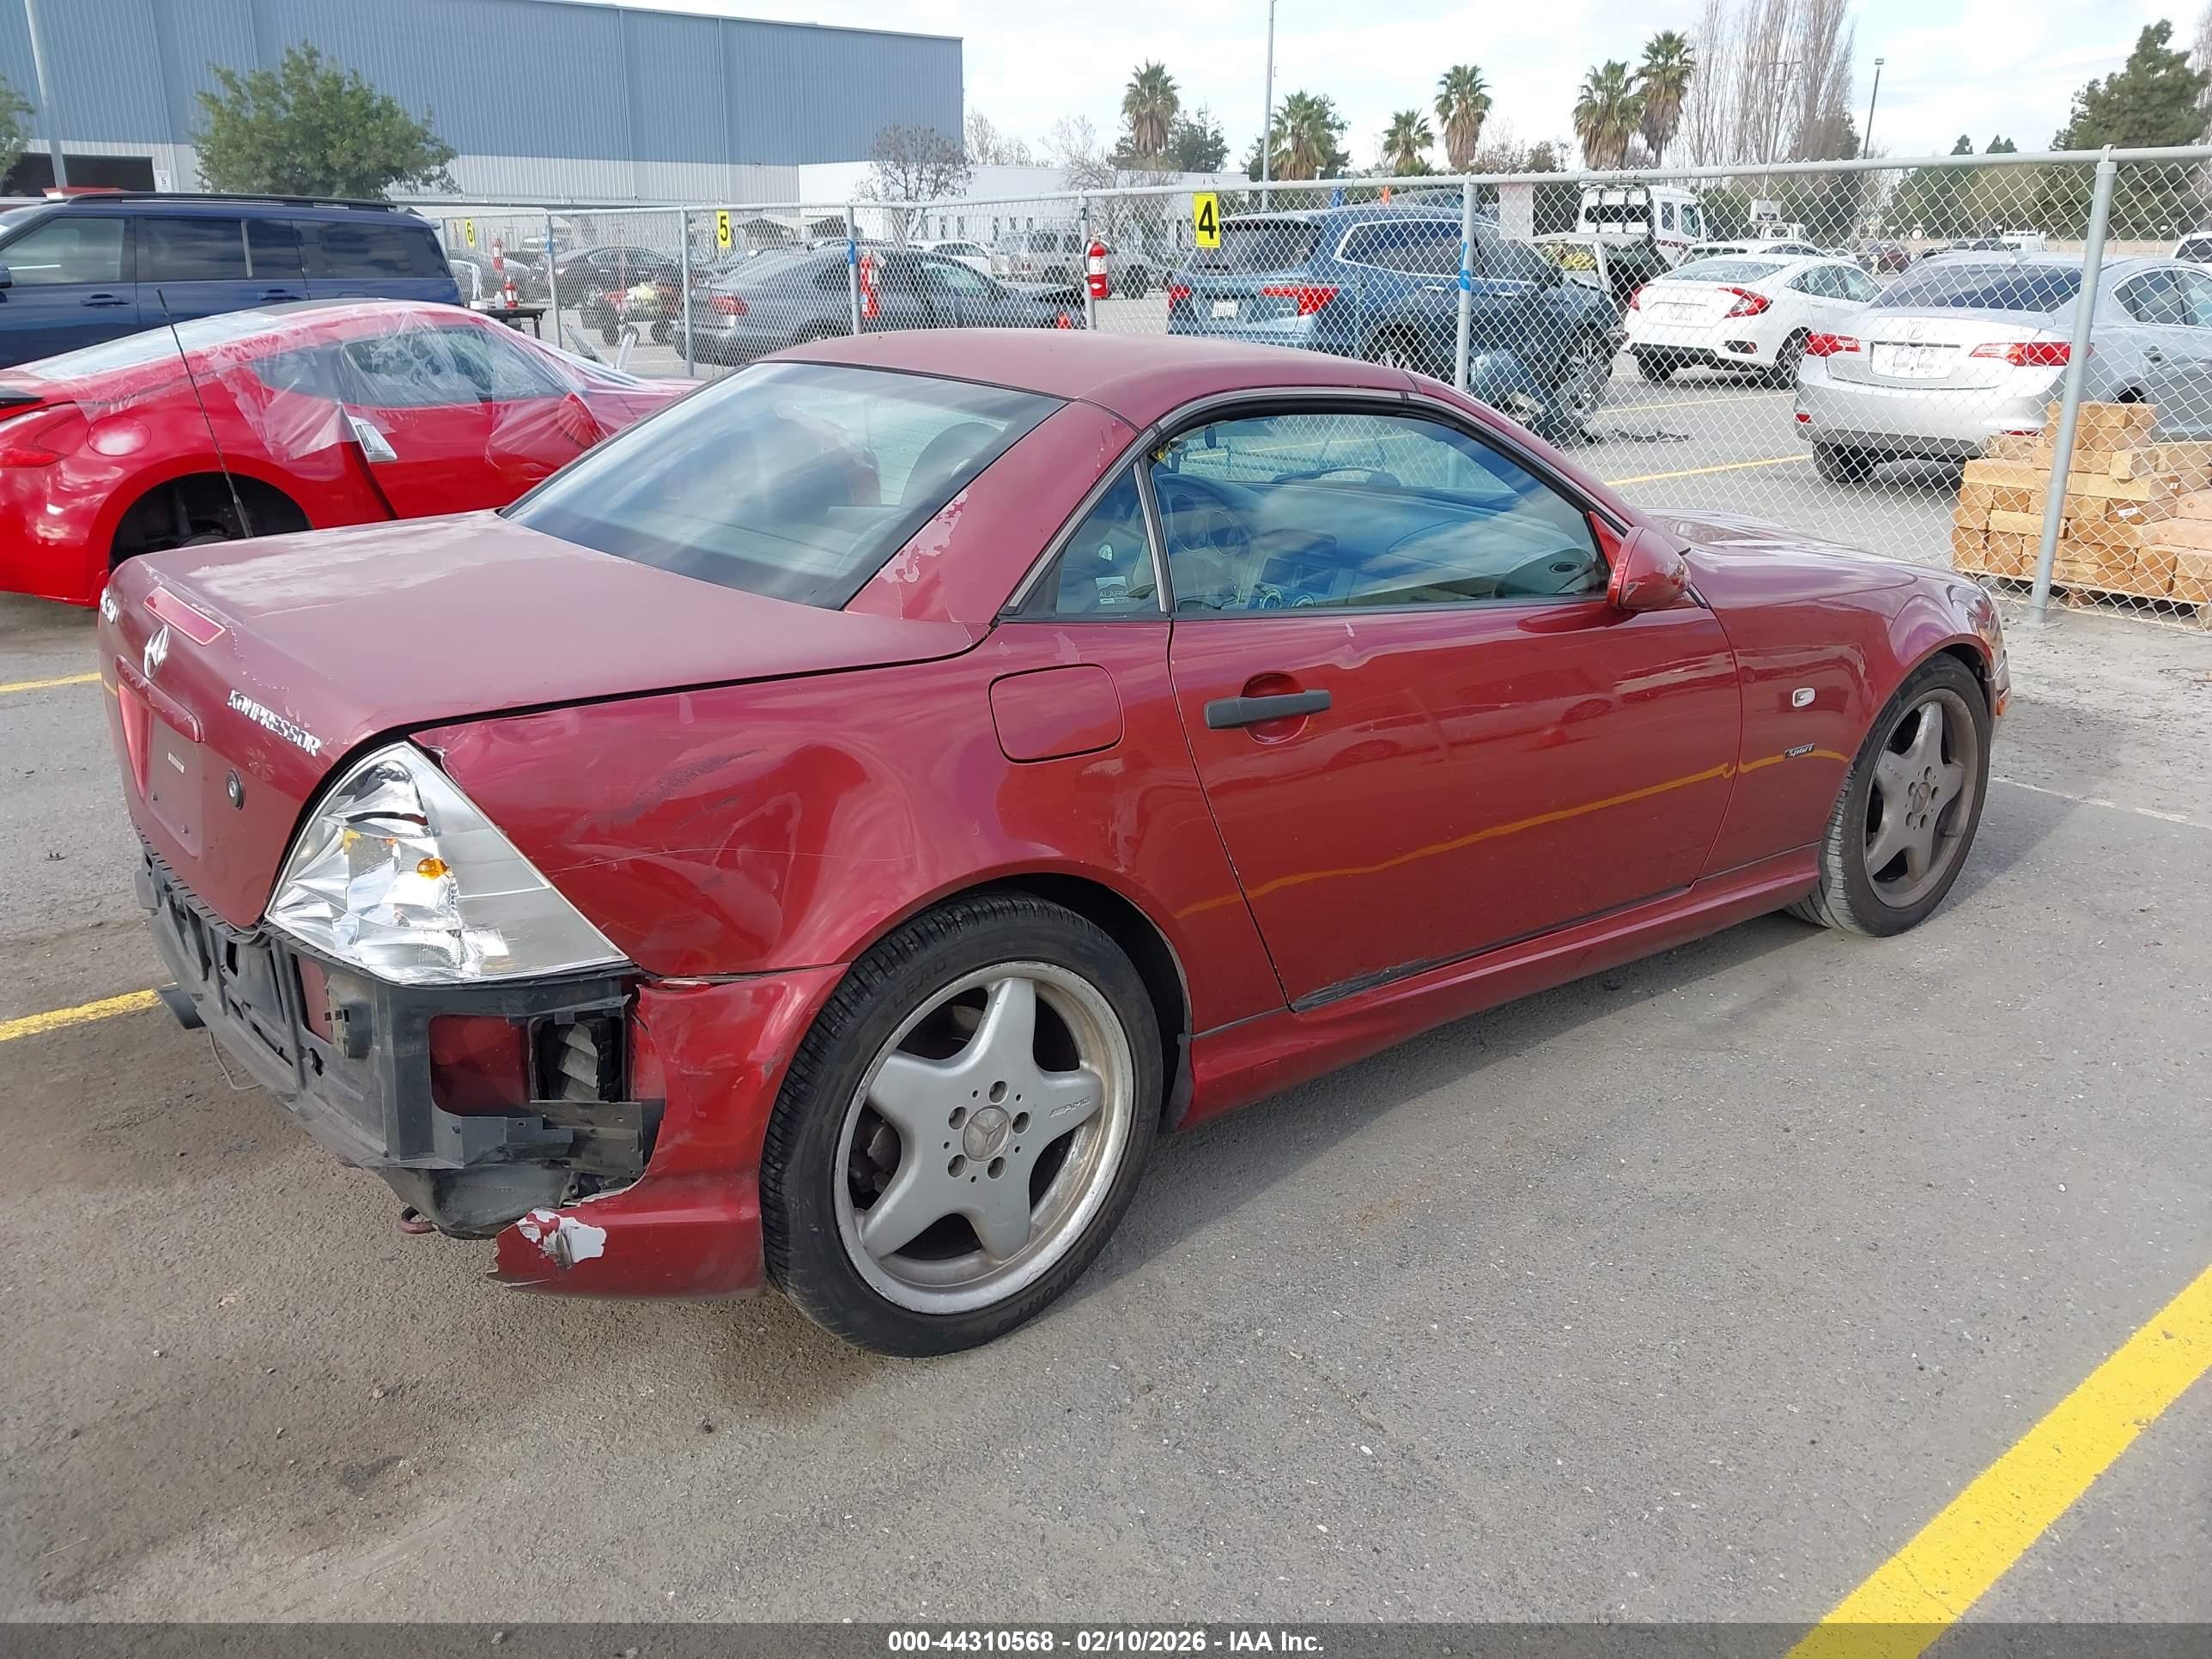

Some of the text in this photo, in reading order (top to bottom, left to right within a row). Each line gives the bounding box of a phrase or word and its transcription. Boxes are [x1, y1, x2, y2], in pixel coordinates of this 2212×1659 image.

[1080, 207, 1087, 221] 2
[1198, 200, 1217, 240] 4
[466, 222, 474, 243] 6
[720, 216, 729, 242] 5
[1098, 590, 1129, 599] ALARM
[227, 689, 321, 757] KOMPRESSOR
[1062, 1095, 1092, 1115] AMG
[1014, 1260, 1083, 1320] SPORT
